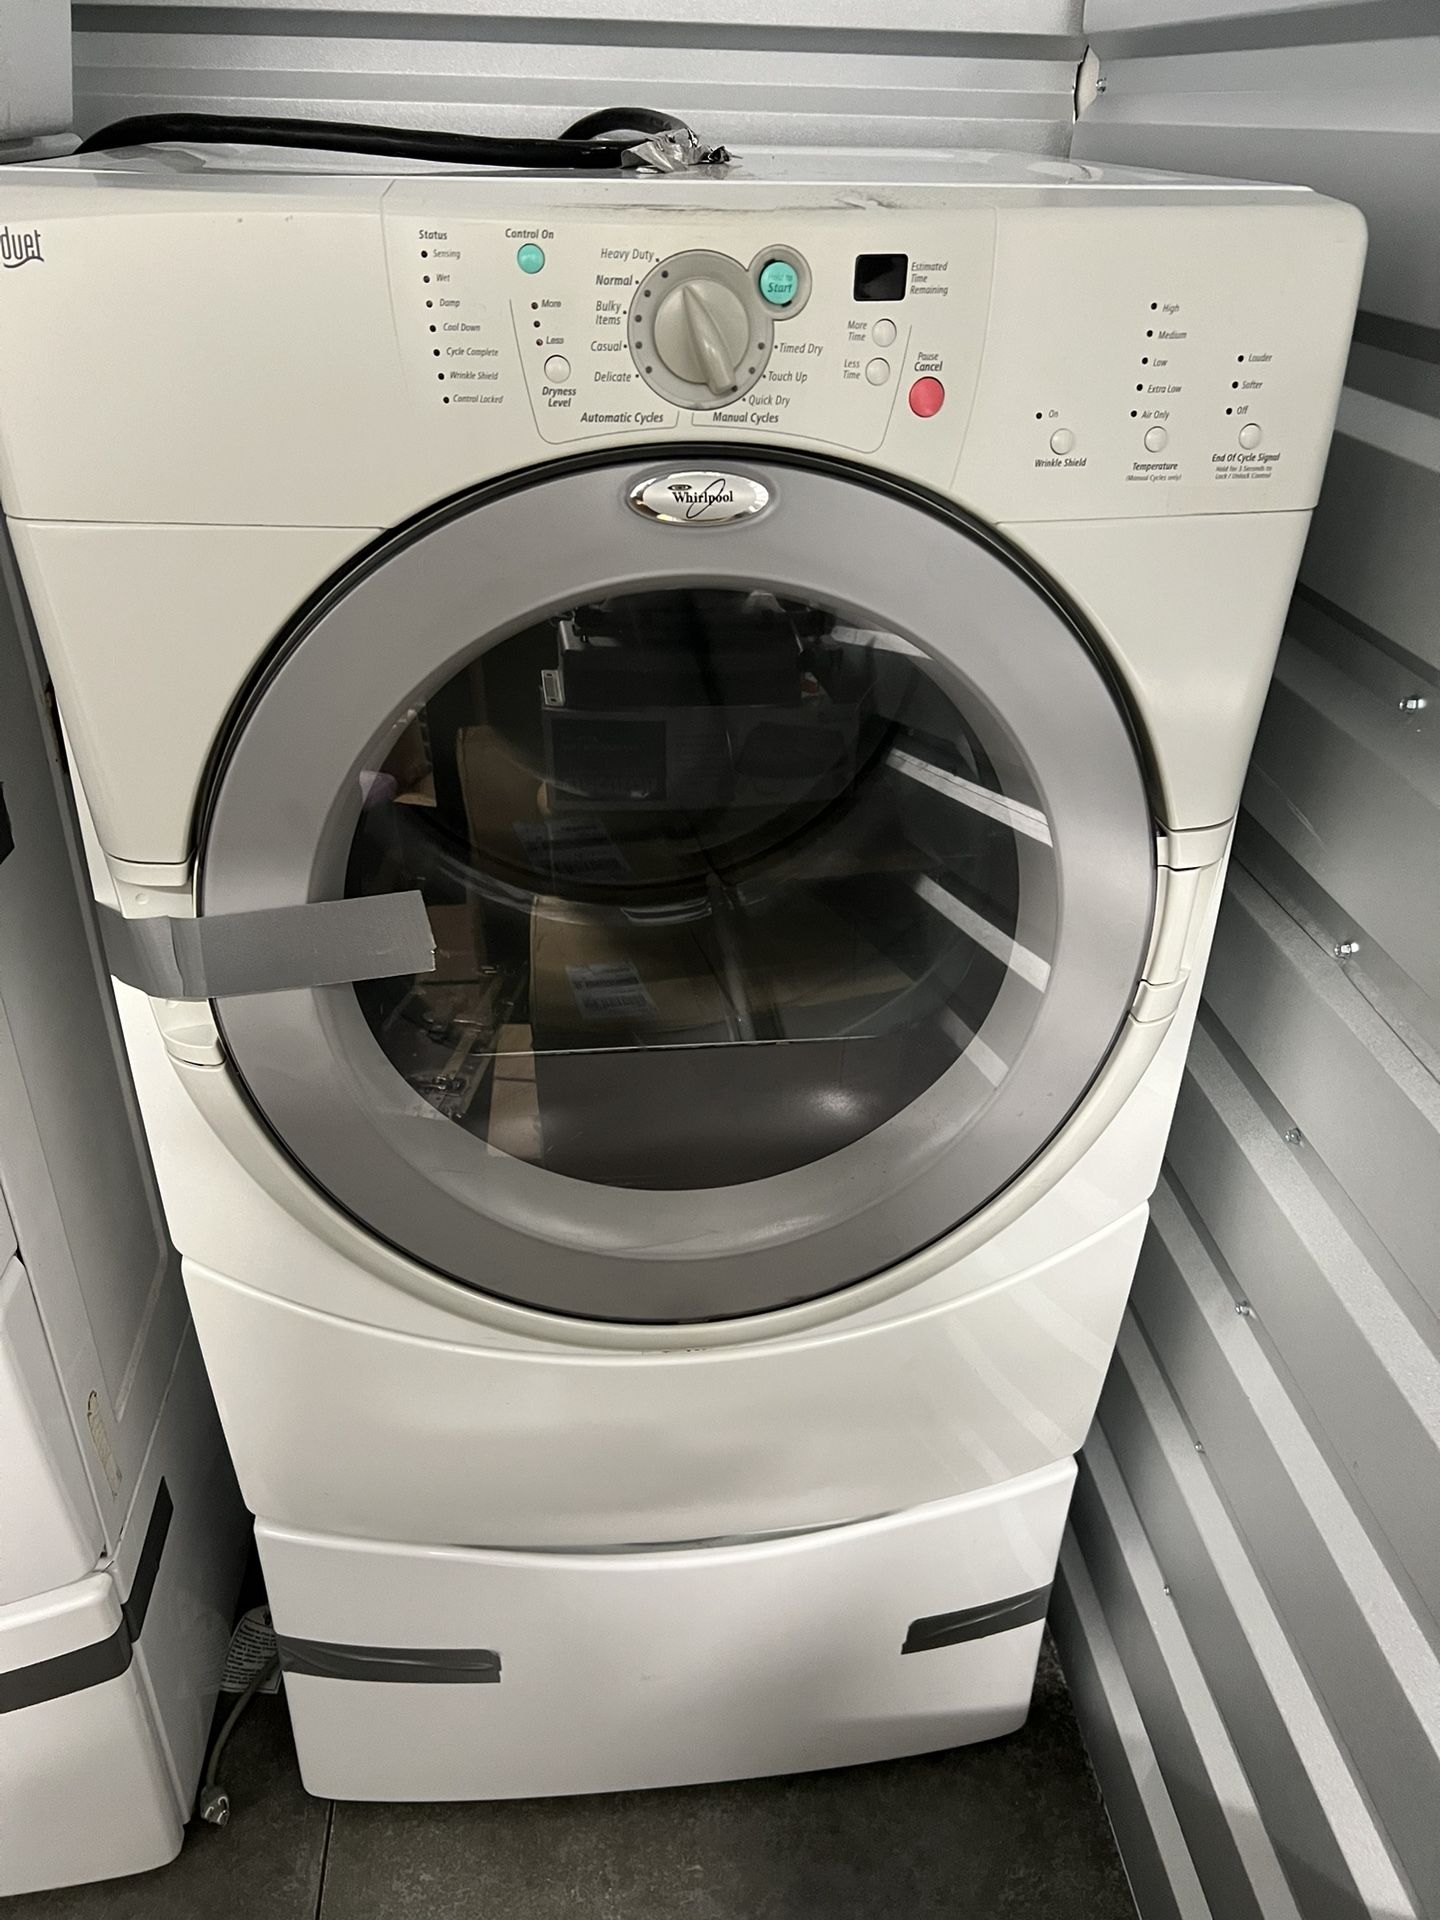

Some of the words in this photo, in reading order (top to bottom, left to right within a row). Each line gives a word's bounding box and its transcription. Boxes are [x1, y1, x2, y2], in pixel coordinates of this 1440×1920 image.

[418, 229, 448, 240] Status
[505, 228, 539, 239] Control
[541, 229, 554, 239] On
[0, 226, 44, 268] duet
[433, 248, 461, 260] Sensing
[600, 248, 630, 262] Heavy
[631, 249, 655, 263] Duty
[911, 261, 948, 273] Estimated
[436, 273, 450, 282] Wet
[595, 274, 633, 286] Normal
[910, 273, 928, 284] Time
[767, 282, 793, 293] Start
[910, 284, 949, 297] Remaining
[439, 298, 461, 309] Damp
[541, 299, 562, 309] More
[596, 301, 622, 314] Bulky
[1162, 303, 1180, 314] High
[595, 315, 621, 326] Items
[847, 320, 868, 331] More
[443, 322, 460, 332] Cool
[460, 322, 481, 332] Down
[546, 335, 564, 345] Less
[849, 331, 867, 342] Time
[1158, 330, 1187, 340] Medium
[590, 340, 622, 352] Casual
[779, 342, 806, 355] Timed
[806, 343, 824, 357] Dry
[446, 347, 465, 358] Cycle
[466, 347, 499, 357] Complete
[917, 352, 939, 362] Pause
[1247, 353, 1273, 363] Louder
[843, 359, 861, 370] Less
[914, 361, 944, 373] Cancel
[1152, 358, 1168, 367] Low
[450, 371, 477, 380] Wrinkle
[477, 371, 499, 380] Shield
[594, 371, 632, 383] Delicate
[768, 371, 794, 383] Touch
[795, 372, 808, 384] Up
[843, 370, 861, 381] Time
[1147, 384, 1165, 394] Extra
[1166, 384, 1182, 394] Low
[1241, 380, 1263, 390] Softer
[542, 386, 577, 399] Dryness
[452, 394, 480, 403] Control
[480, 394, 504, 404] Locked
[548, 397, 572, 408] Level
[748, 394, 773, 408] Quick
[775, 395, 791, 409] Dry
[1048, 409, 1059, 419] On
[1141, 409, 1153, 419] Air
[1153, 409, 1170, 421] Only
[1236, 405, 1249, 416] Off
[580, 411, 633, 424] Automatic
[634, 411, 664, 425] Cycles
[713, 411, 748, 424] Manual
[750, 411, 779, 425] Cycles
[1034, 457, 1063, 468] Wrinkle
[1063, 457, 1087, 468] Shield
[1211, 453, 1226, 463] End
[1226, 453, 1237, 462] Of
[1237, 452, 1257, 464] Cycle
[1257, 452, 1281, 464] Signal
[1132, 462, 1179, 473] Temperature
[672, 490, 734, 505] Whirlpool
